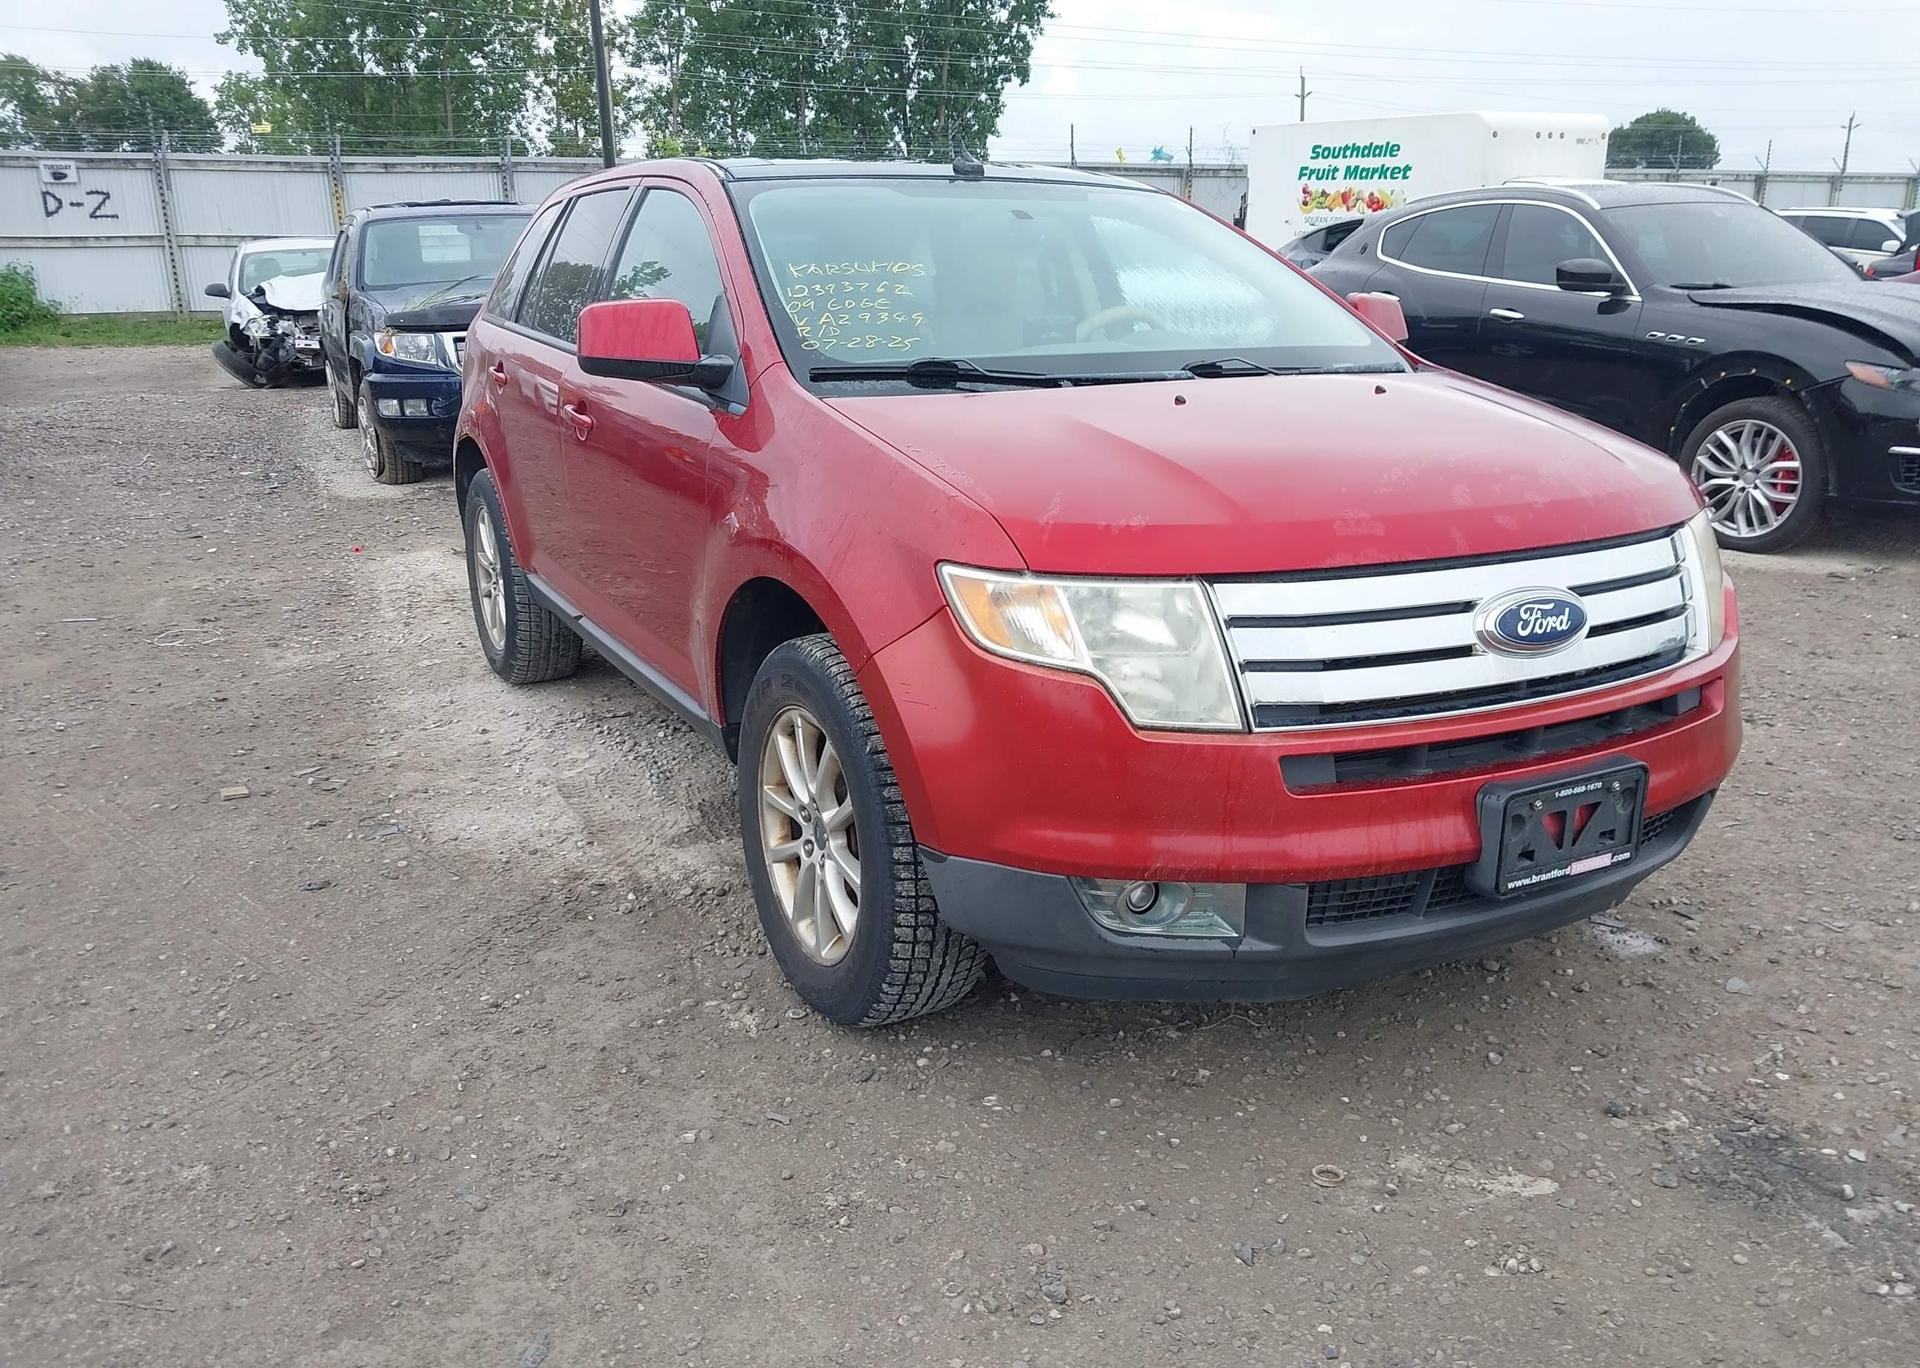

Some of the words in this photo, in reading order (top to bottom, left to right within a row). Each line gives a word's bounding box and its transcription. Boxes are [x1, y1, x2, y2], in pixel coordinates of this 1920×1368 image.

[1310, 141, 1401, 160] Southdale
[1298, 166, 1339, 181] Fruit
[1344, 163, 1412, 181] Market
[41, 190, 119, 219] D-Z
[787, 299, 815, 313] 09
[827, 298, 891, 311] EDGE
[1517, 602, 1571, 637] Ford
